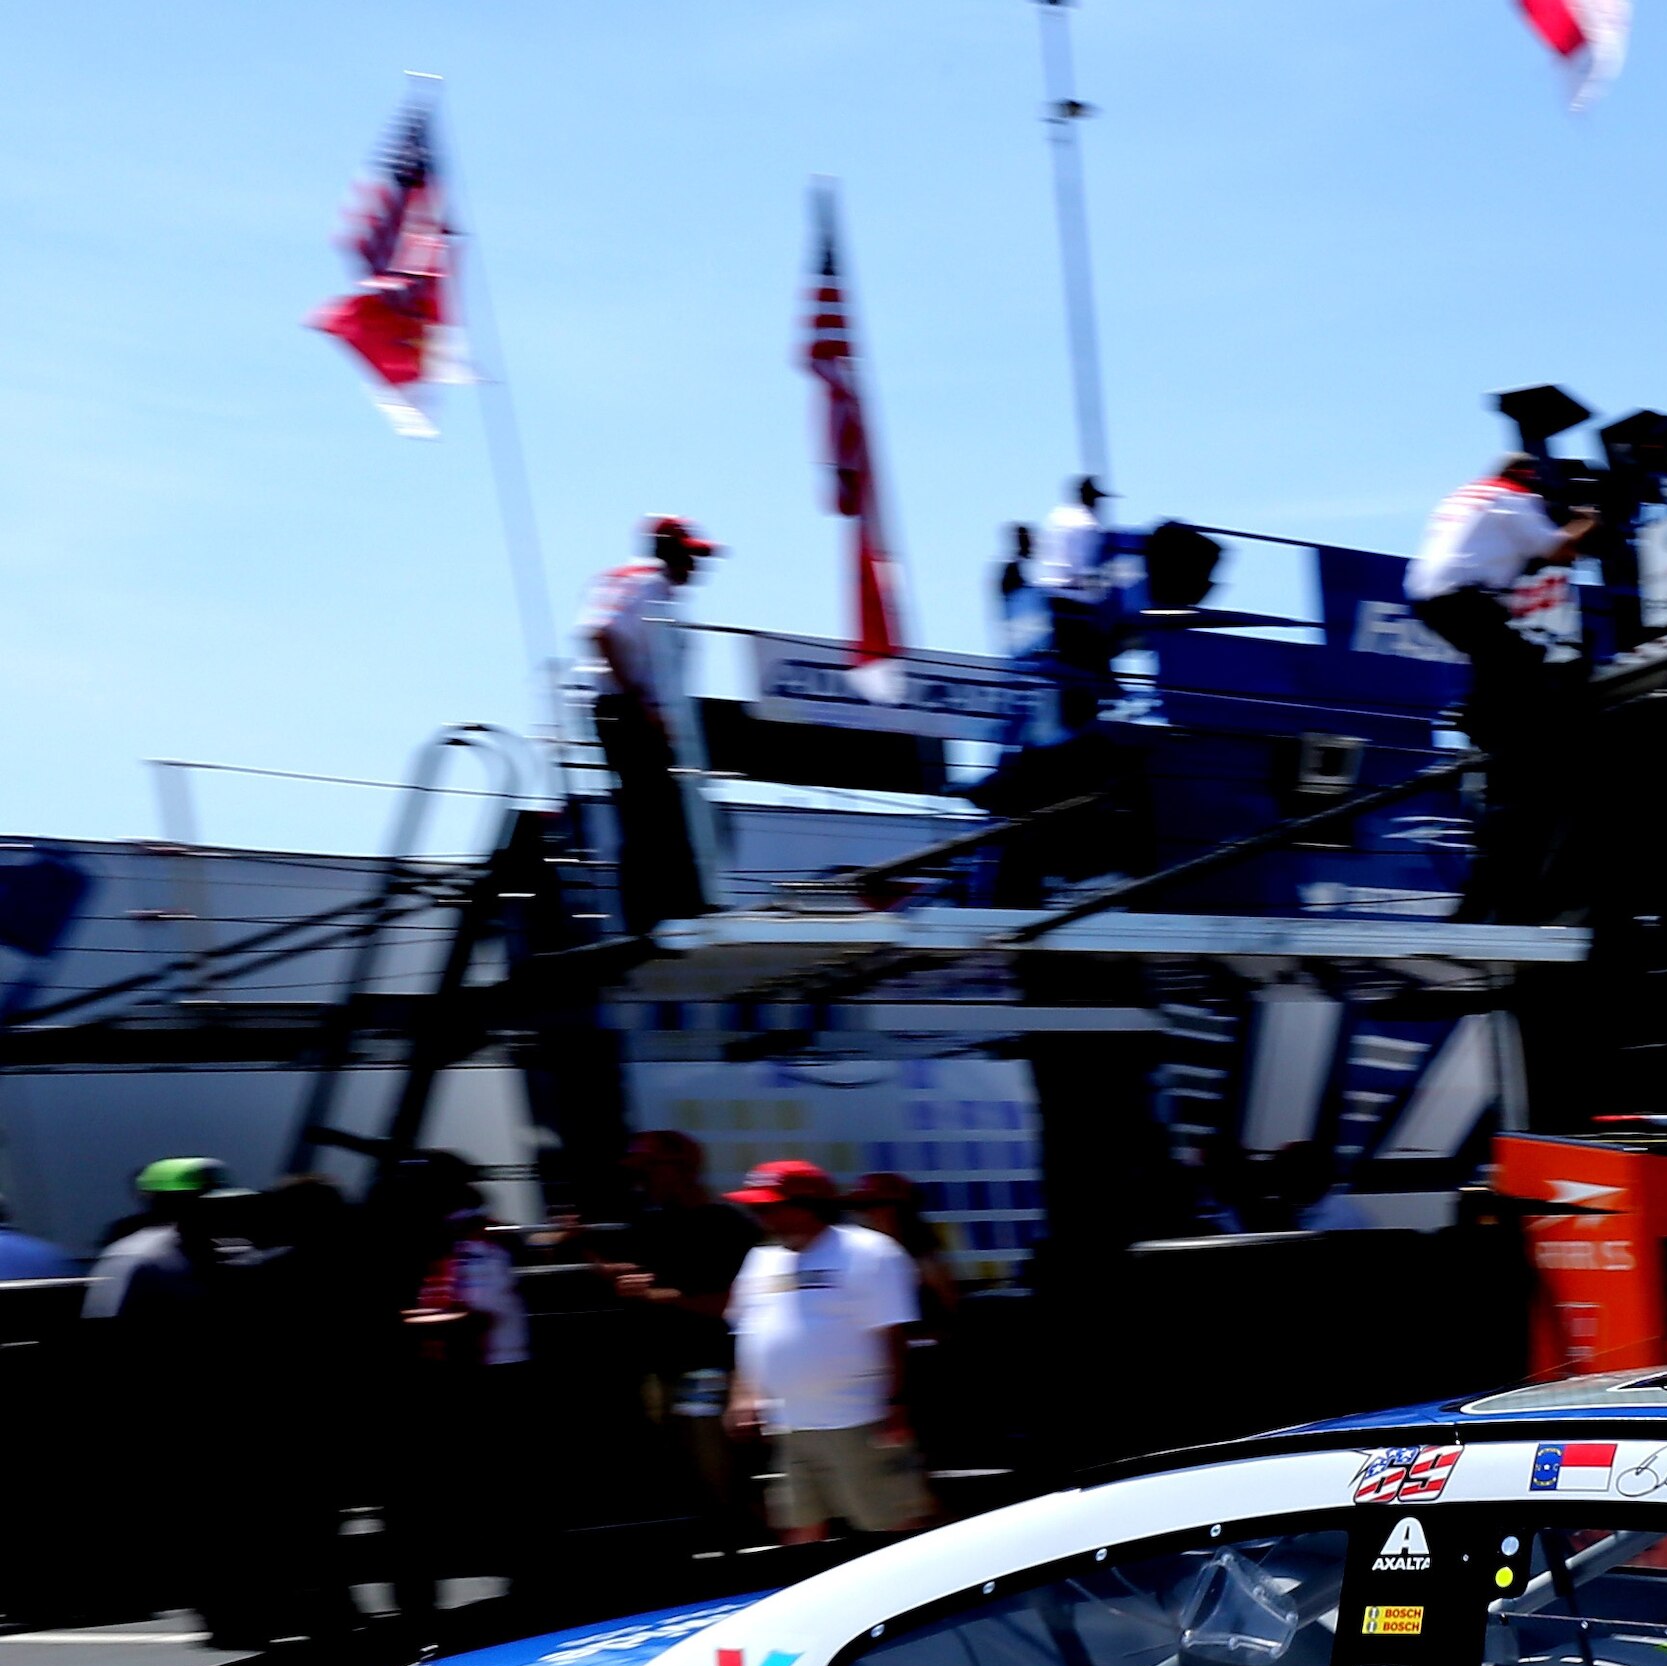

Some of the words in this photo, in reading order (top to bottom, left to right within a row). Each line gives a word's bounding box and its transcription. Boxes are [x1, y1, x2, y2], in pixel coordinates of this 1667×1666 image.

[1372, 1557, 1430, 1570] AXALTA
[1385, 1609, 1421, 1618] BOSCH
[1383, 1622, 1420, 1631] BOSCH
